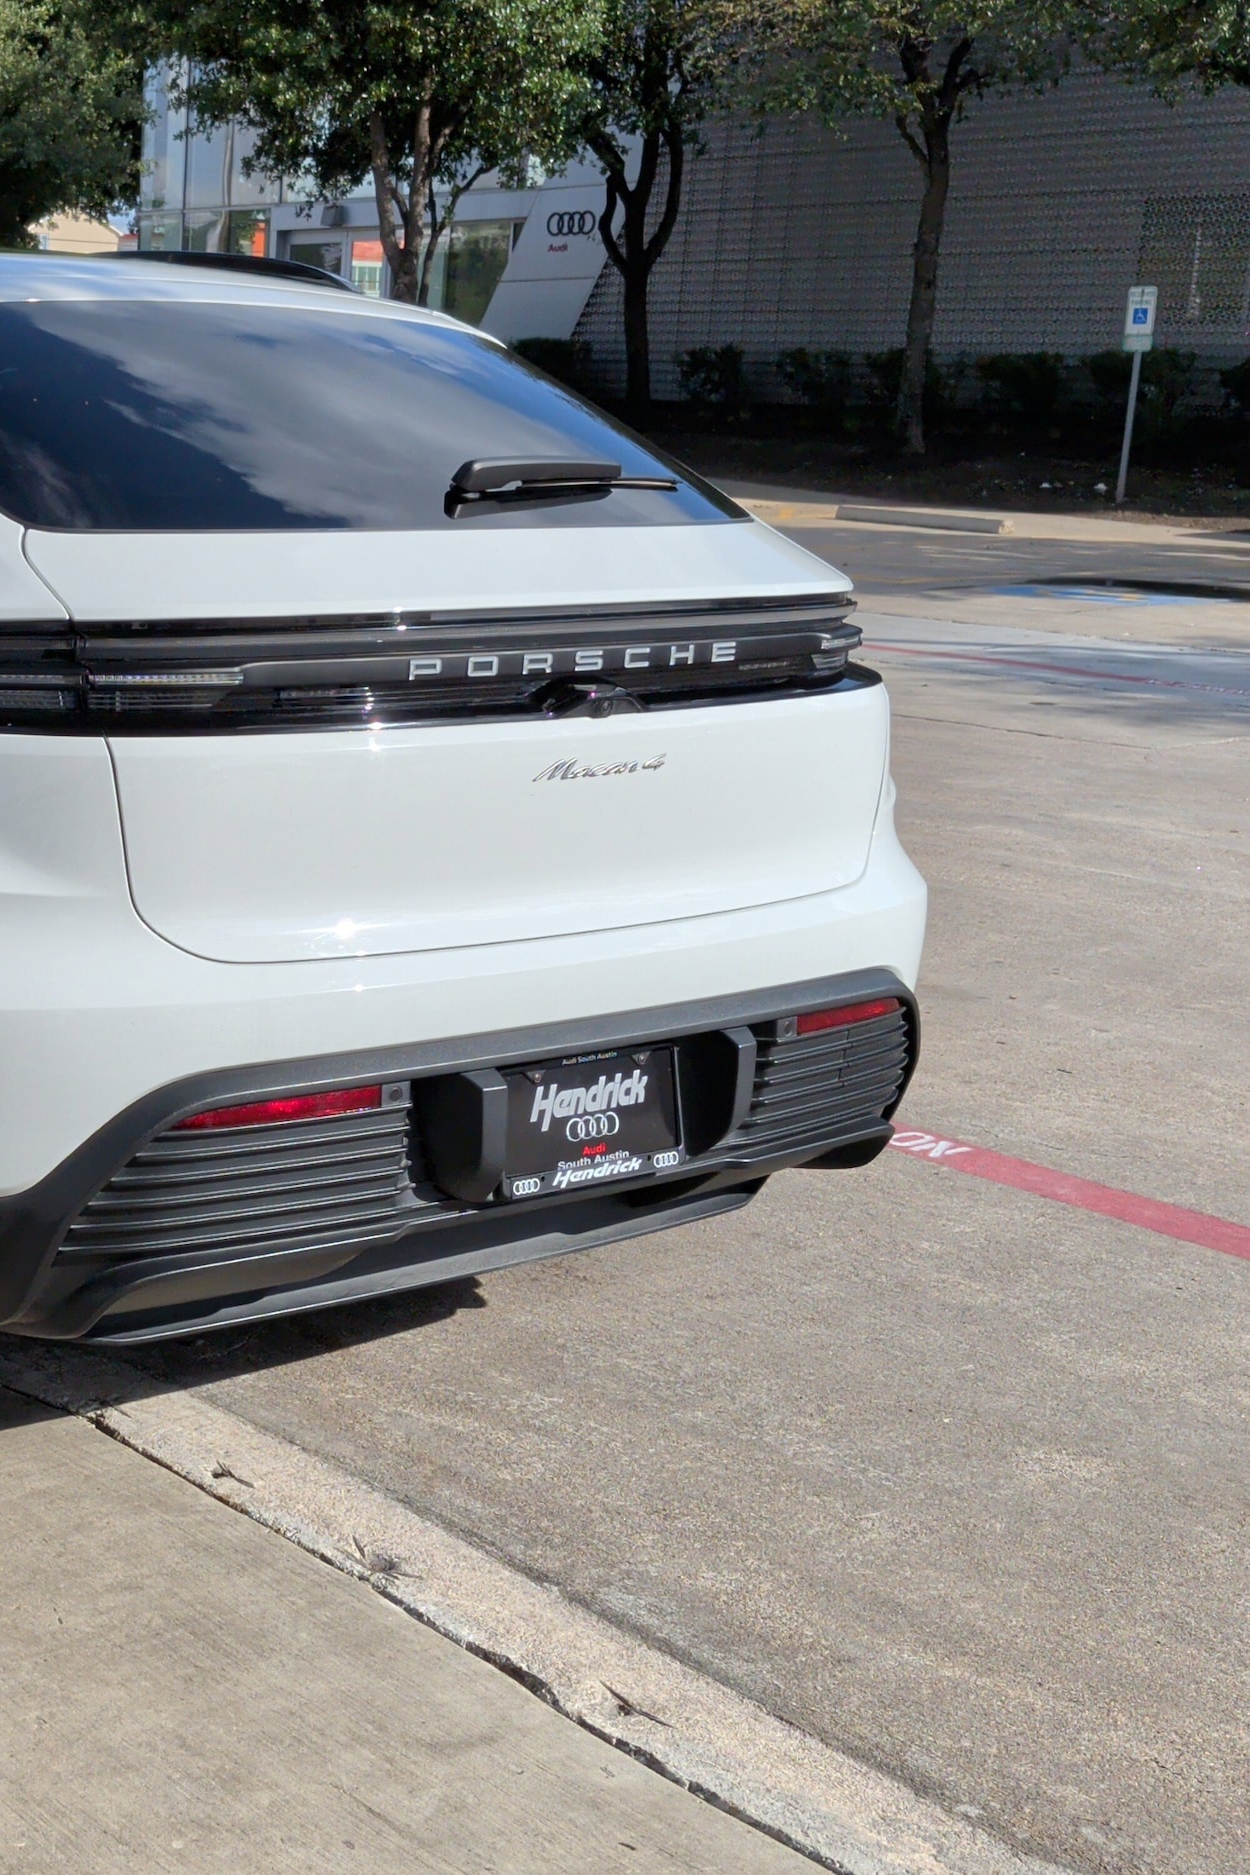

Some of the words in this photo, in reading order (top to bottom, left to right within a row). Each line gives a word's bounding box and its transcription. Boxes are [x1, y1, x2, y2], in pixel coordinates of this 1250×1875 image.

[547, 243, 568, 253] Audi
[409, 641, 737, 681] PORSCHE
[532, 757, 639, 782] Macan
[642, 752, 667, 770] 4
[561, 1056, 578, 1066] Audi
[577, 1054, 597, 1064] South
[596, 1050, 618, 1060] Austin
[529, 1069, 649, 1133] Hendrick
[557, 1157, 591, 1171] South
[594, 1149, 630, 1164] Austin
[582, 1142, 607, 1156] Audi
[552, 1157, 643, 1189] Hendrick
